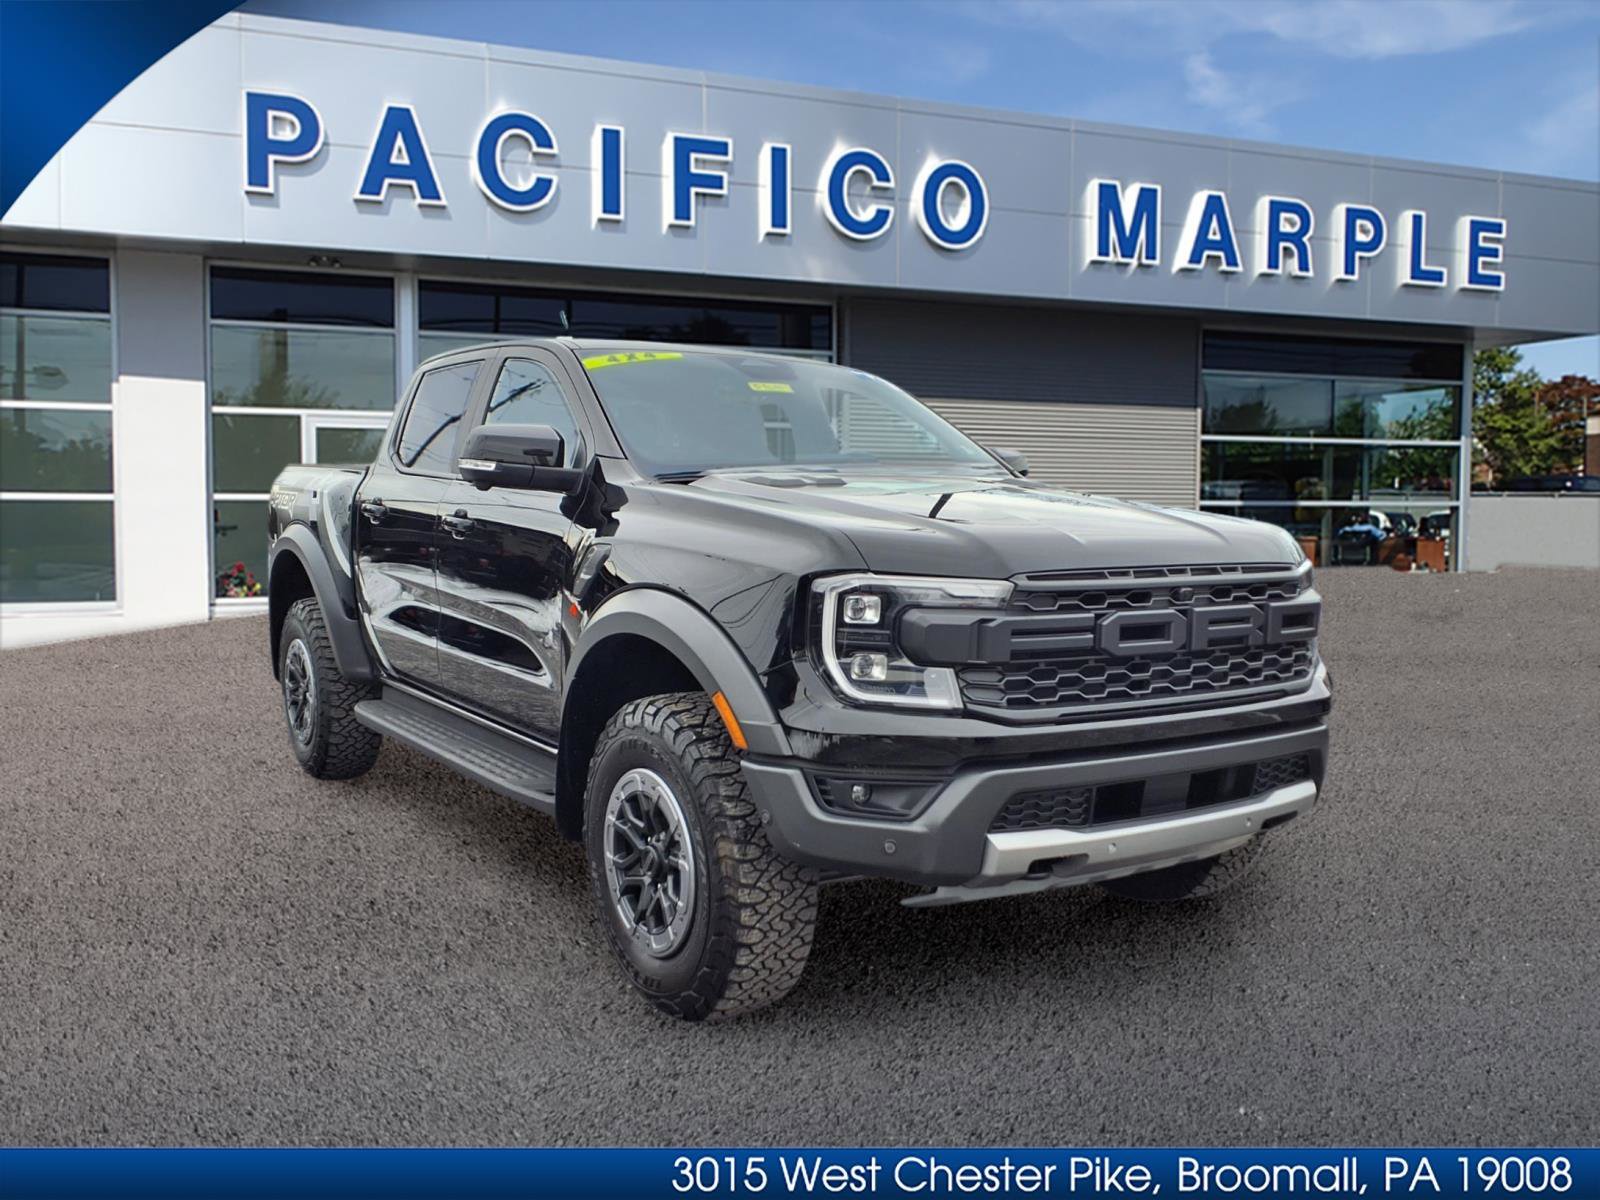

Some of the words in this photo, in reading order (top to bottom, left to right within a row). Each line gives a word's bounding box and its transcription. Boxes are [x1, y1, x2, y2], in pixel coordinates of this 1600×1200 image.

[242, 89, 989, 250] PACIFICO
[1088, 179, 1507, 291] MARPLE
[977, 599, 1321, 664] FORD
